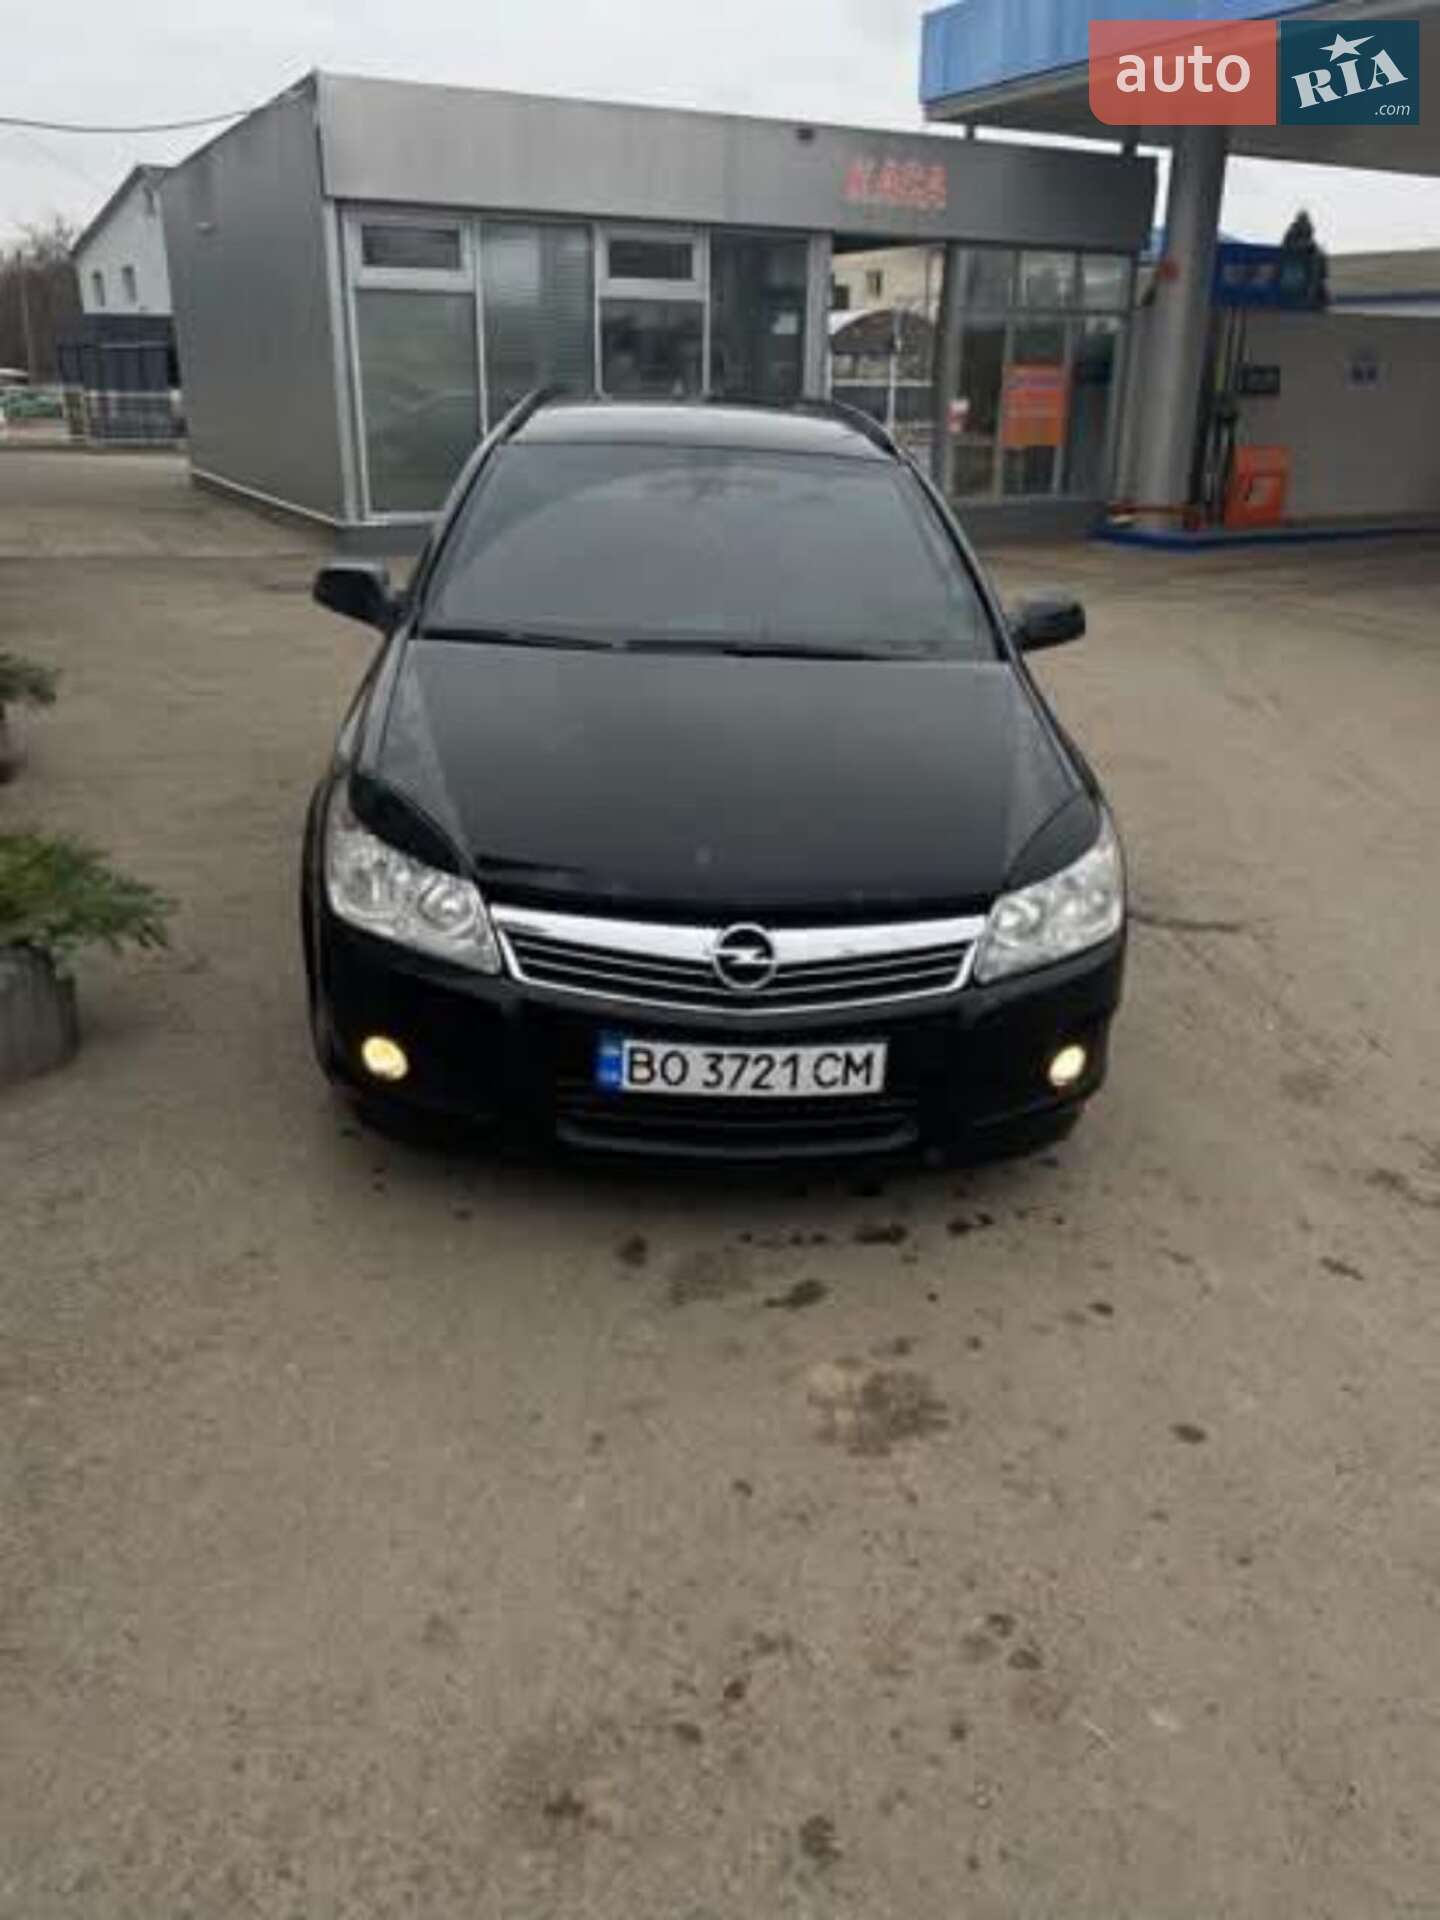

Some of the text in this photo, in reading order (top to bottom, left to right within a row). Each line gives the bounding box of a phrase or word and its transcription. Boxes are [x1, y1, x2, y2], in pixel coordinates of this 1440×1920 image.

[628, 1048, 875, 1091] BO 3721 CM
